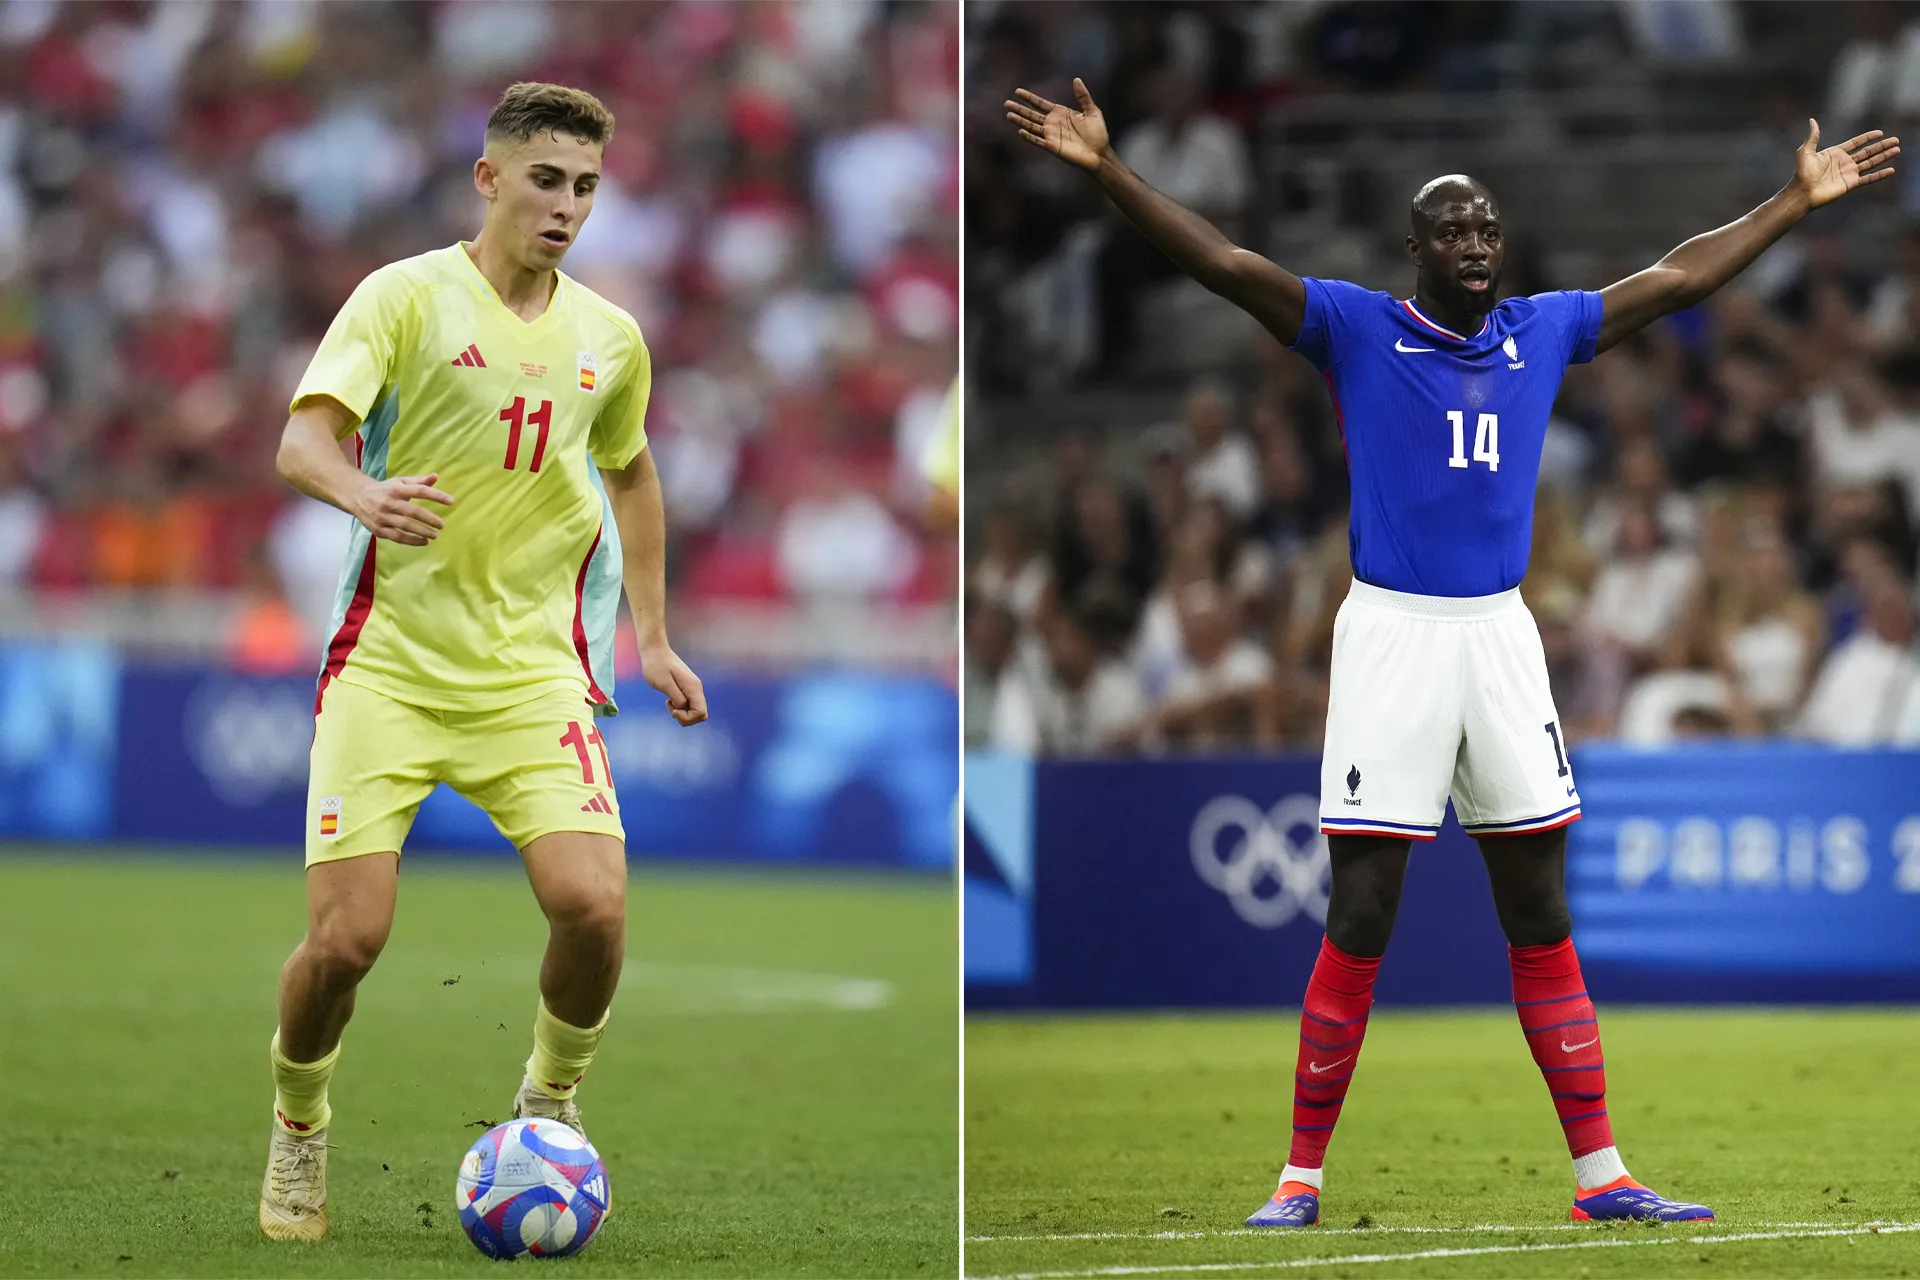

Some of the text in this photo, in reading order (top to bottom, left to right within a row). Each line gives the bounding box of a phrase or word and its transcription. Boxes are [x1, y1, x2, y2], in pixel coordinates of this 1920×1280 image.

[499, 396, 553, 473] 11
[1446, 410, 1500, 472] 14
[559, 721, 614, 790] 11
[1544, 721, 1569, 778] 1
[1343, 797, 1362, 807] FRANCE
[1615, 817, 1871, 893] PARIS
